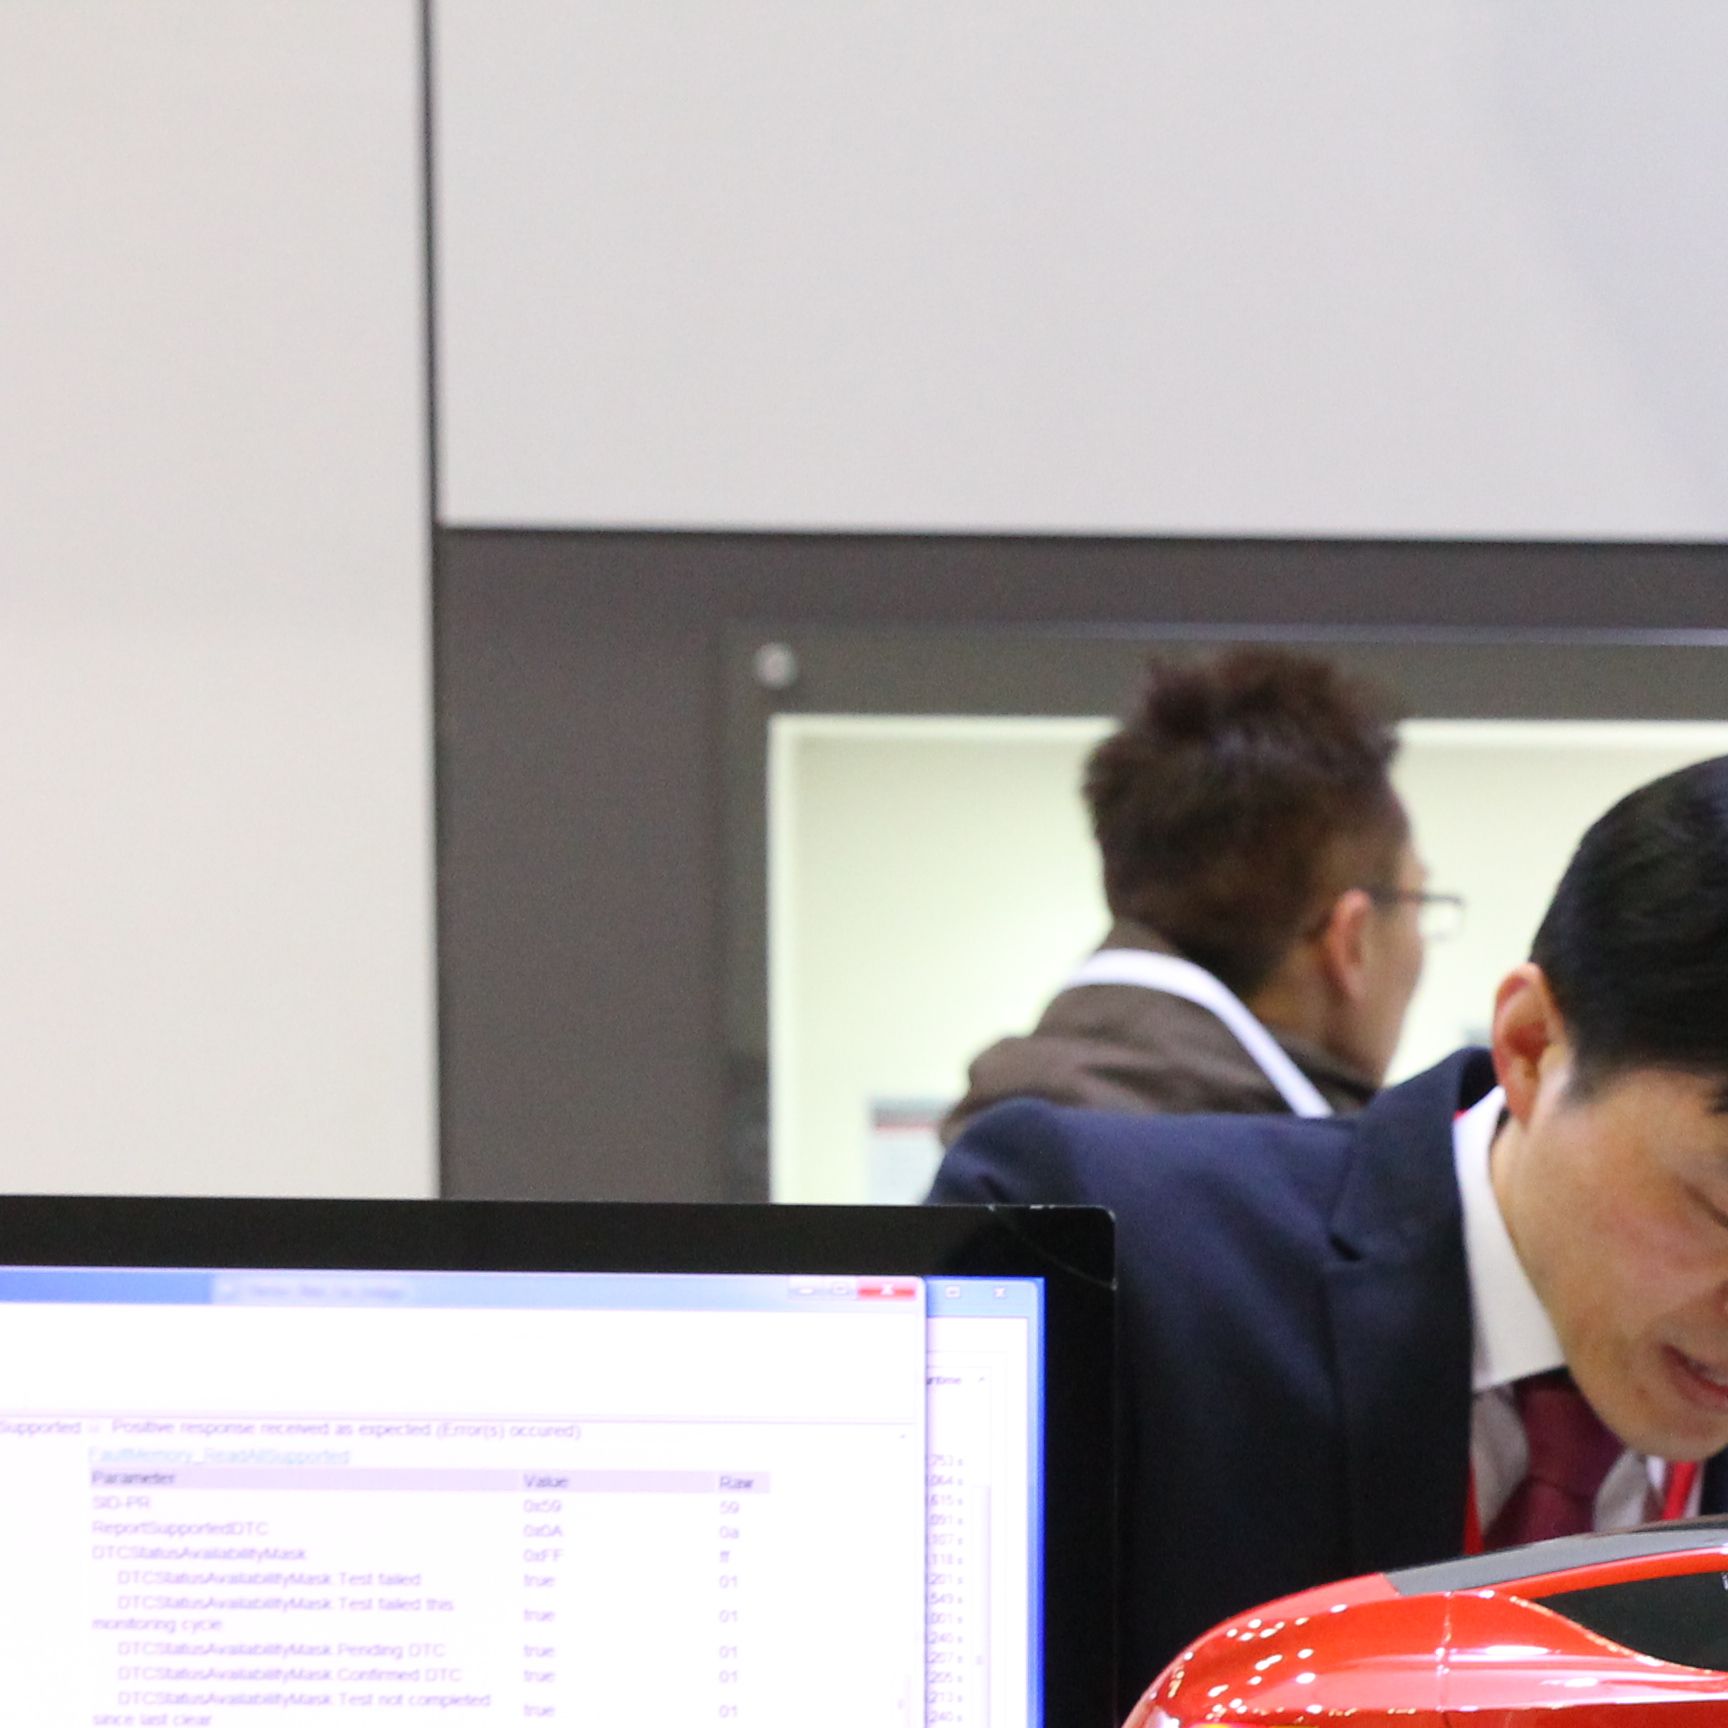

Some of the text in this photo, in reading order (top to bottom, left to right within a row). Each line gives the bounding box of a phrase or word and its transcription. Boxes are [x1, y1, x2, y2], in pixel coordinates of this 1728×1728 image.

[522, 1574, 557, 1587] true
[718, 1575, 739, 1589] 01
[522, 1609, 557, 1622] true
[717, 1609, 739, 1623] 01
[522, 1645, 556, 1658] true
[718, 1645, 739, 1659] 01
[522, 1670, 557, 1683] true
[717, 1670, 739, 1684] 01
[522, 1704, 557, 1717] true
[717, 1704, 739, 1718] 01
